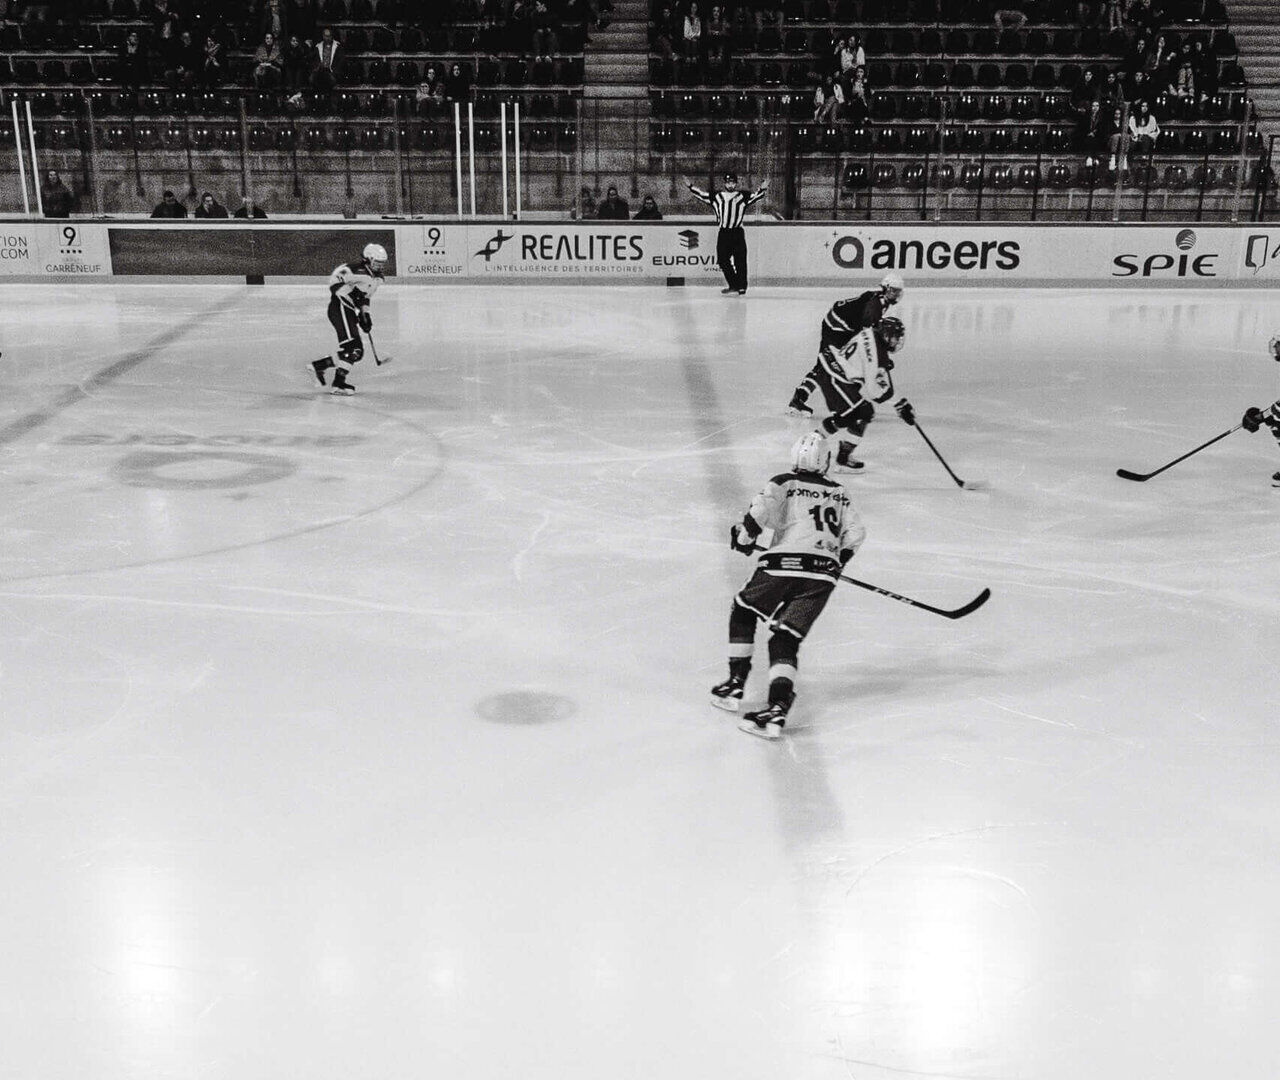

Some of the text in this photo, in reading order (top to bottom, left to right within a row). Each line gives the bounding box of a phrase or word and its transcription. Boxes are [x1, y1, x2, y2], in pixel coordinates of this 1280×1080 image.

[63, 226, 77, 246] 9
[427, 227, 441, 247] 9
[652, 255, 720, 266] EUROVI
[1112, 254, 1219, 277] SPIE
